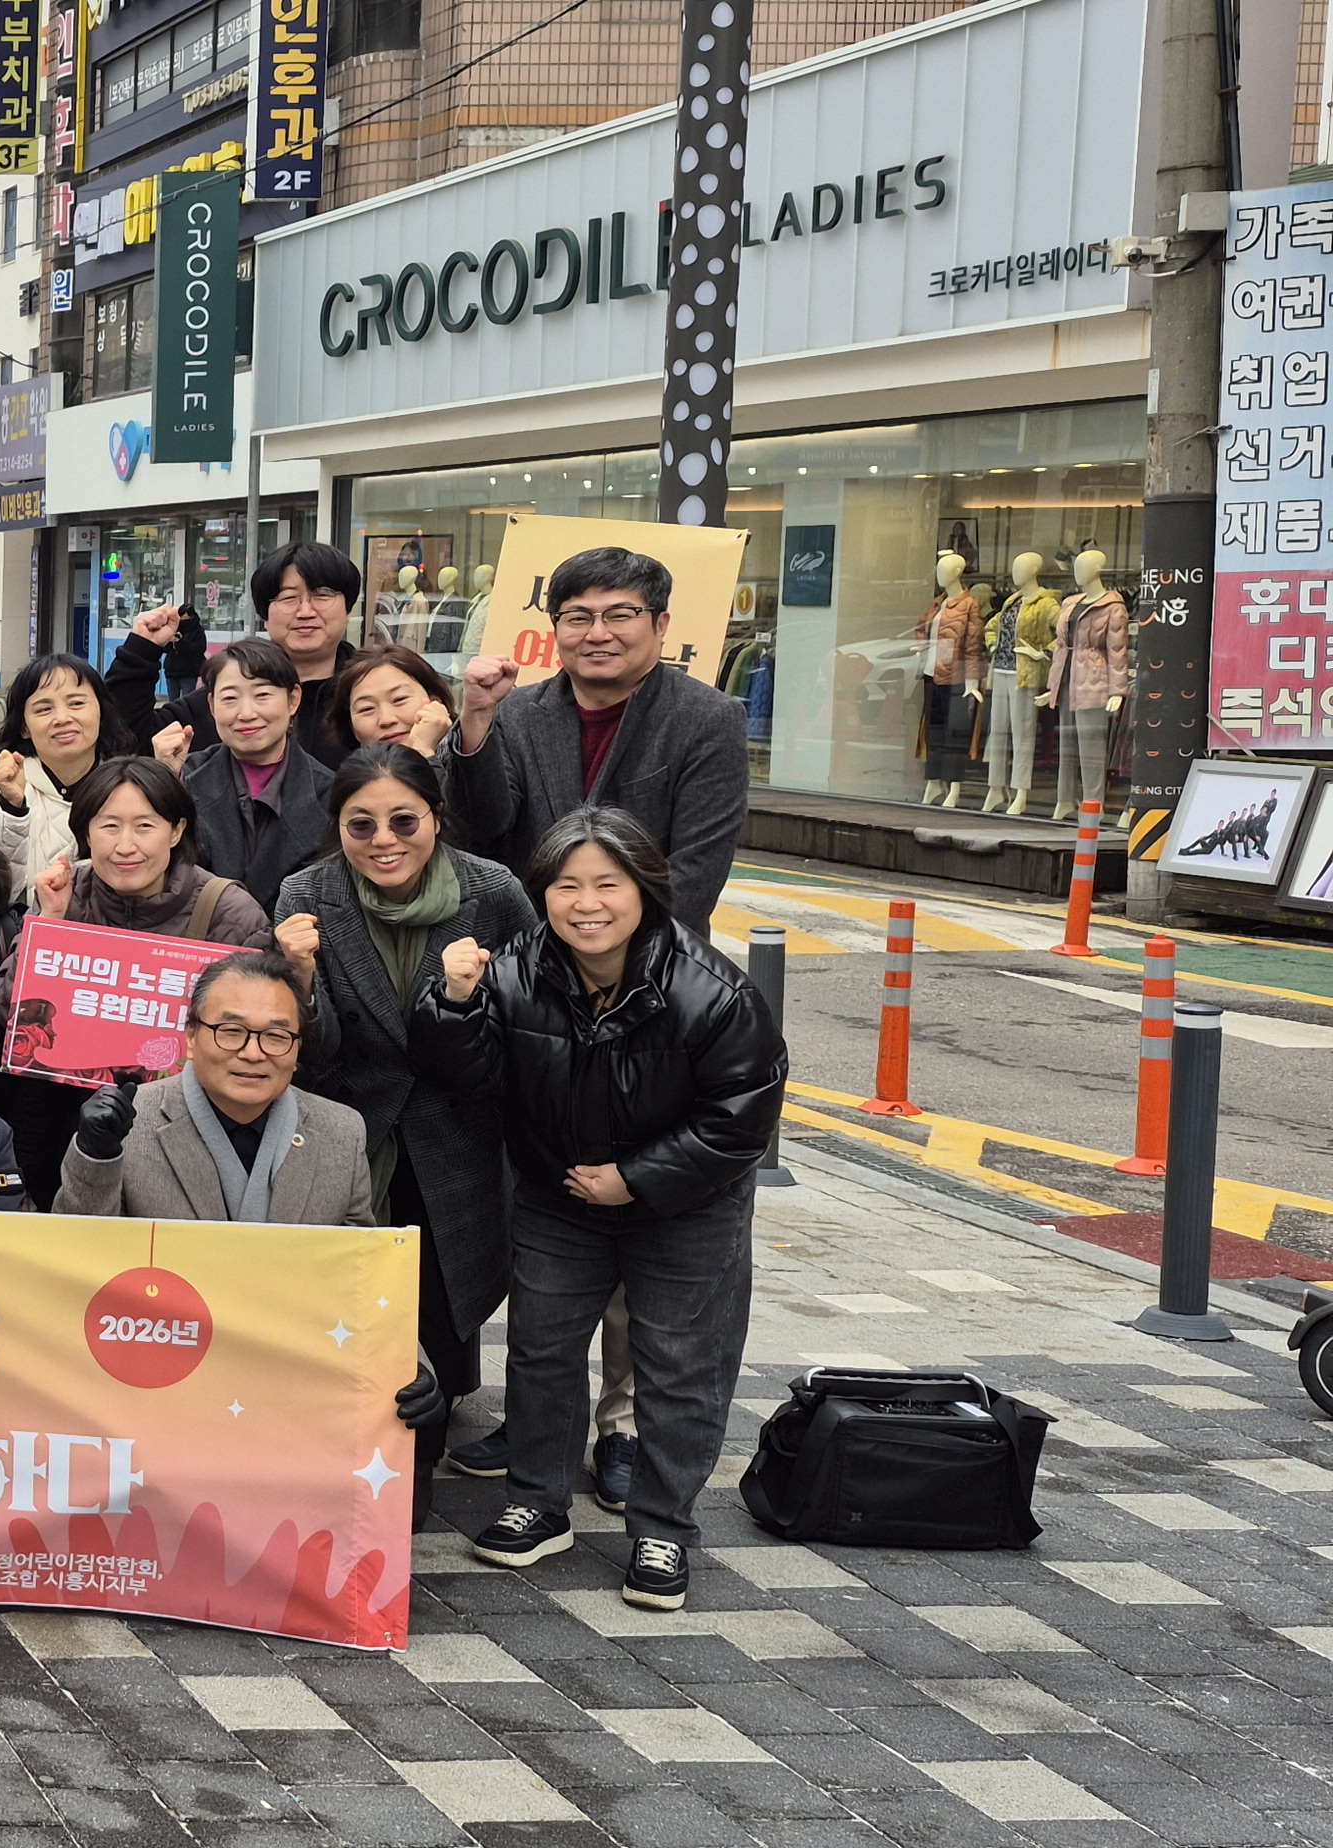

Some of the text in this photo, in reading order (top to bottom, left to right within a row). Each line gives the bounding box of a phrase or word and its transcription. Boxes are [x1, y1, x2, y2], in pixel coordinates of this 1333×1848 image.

[267, 0, 320, 162] 인후과
[273, 170, 312, 191] 2F
[742, 152, 947, 248] LADIES
[928, 238, 1109, 298] 크로커다일레이디
[182, 202, 214, 413] CROCODILE
[1227, 351, 1328, 412] 취업
[173, 422, 216, 433] LADIES
[34, 948, 120, 987] 당신의
[70, 988, 190, 1032] 응원합니
[98, 1313, 200, 1347] 2026년
[44, 1571, 149, 1597] 시흥시지부
